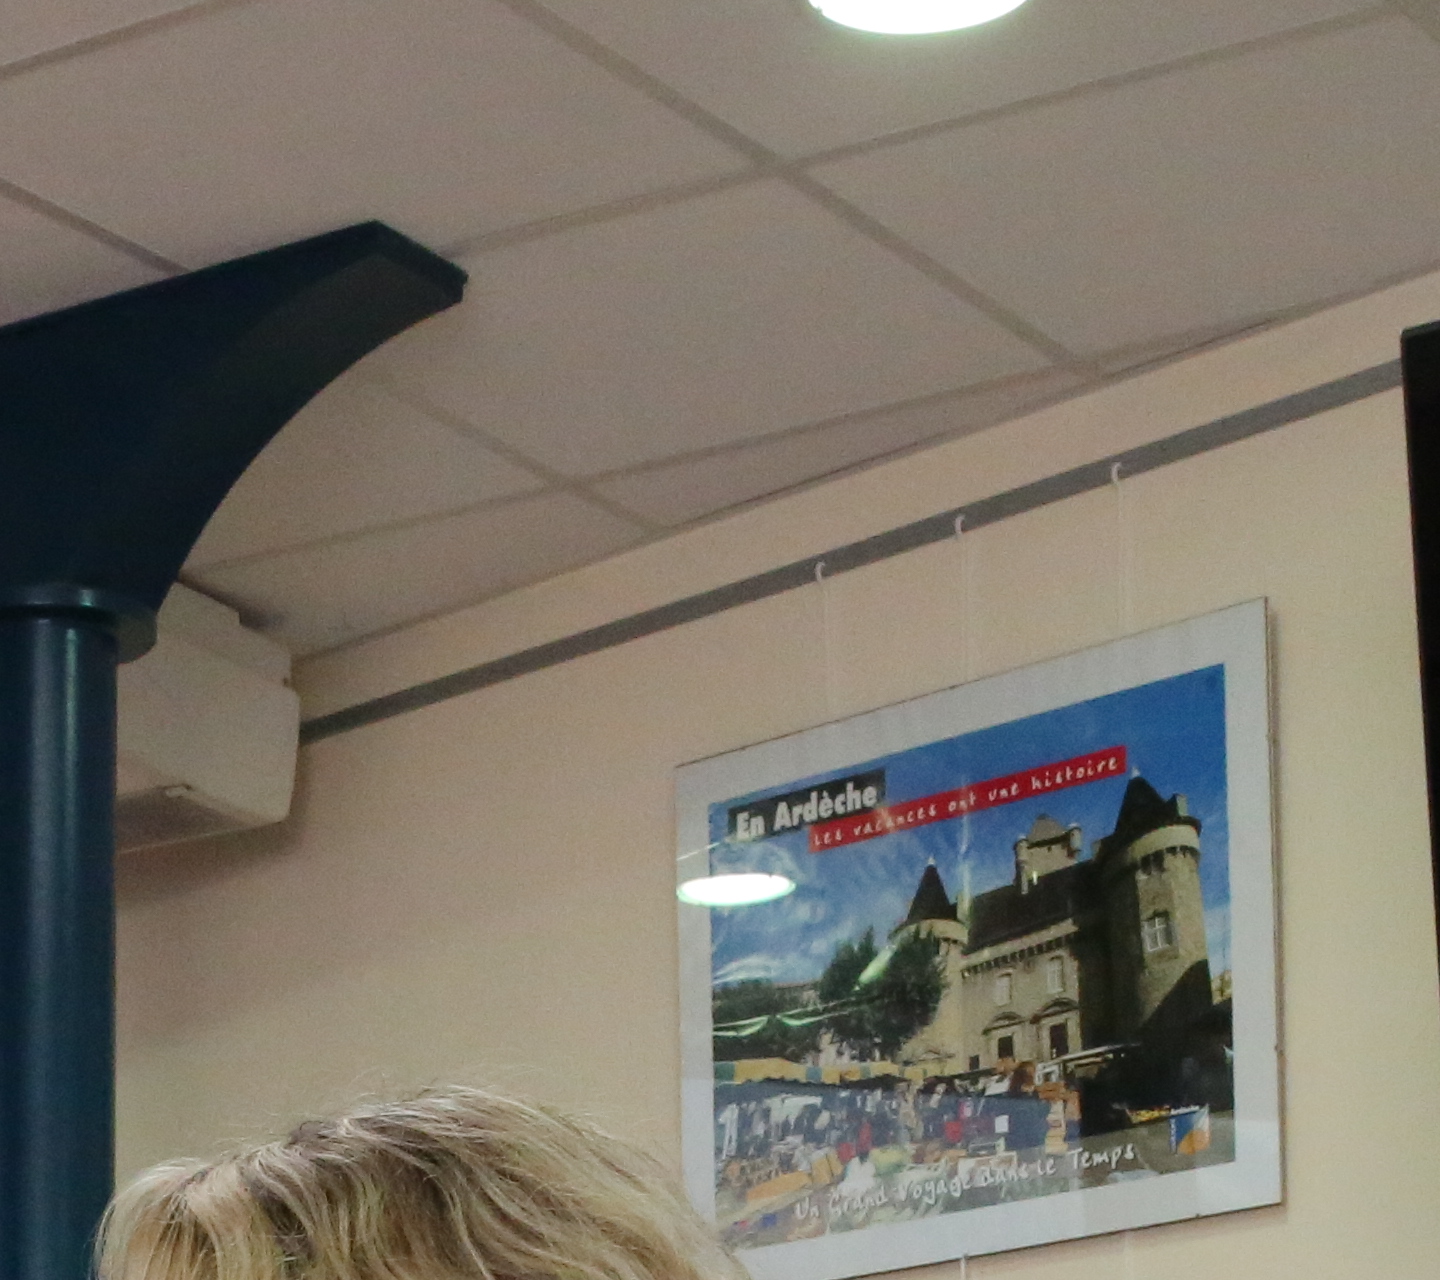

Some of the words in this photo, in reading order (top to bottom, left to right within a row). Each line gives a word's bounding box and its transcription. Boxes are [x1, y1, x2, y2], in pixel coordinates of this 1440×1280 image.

[736, 810, 765, 839] En
[773, 782, 878, 832] Ardèche
[853, 804, 937, 837] vacances
[948, 792, 978, 816] ont
[987, 782, 1021, 803] une
[1030, 756, 1119, 791] histoire
[794, 1198, 819, 1222] Un
[828, 1186, 888, 1219] Grand
[901, 1171, 971, 1206] Voyage
[1067, 1142, 1136, 1172] Temps
